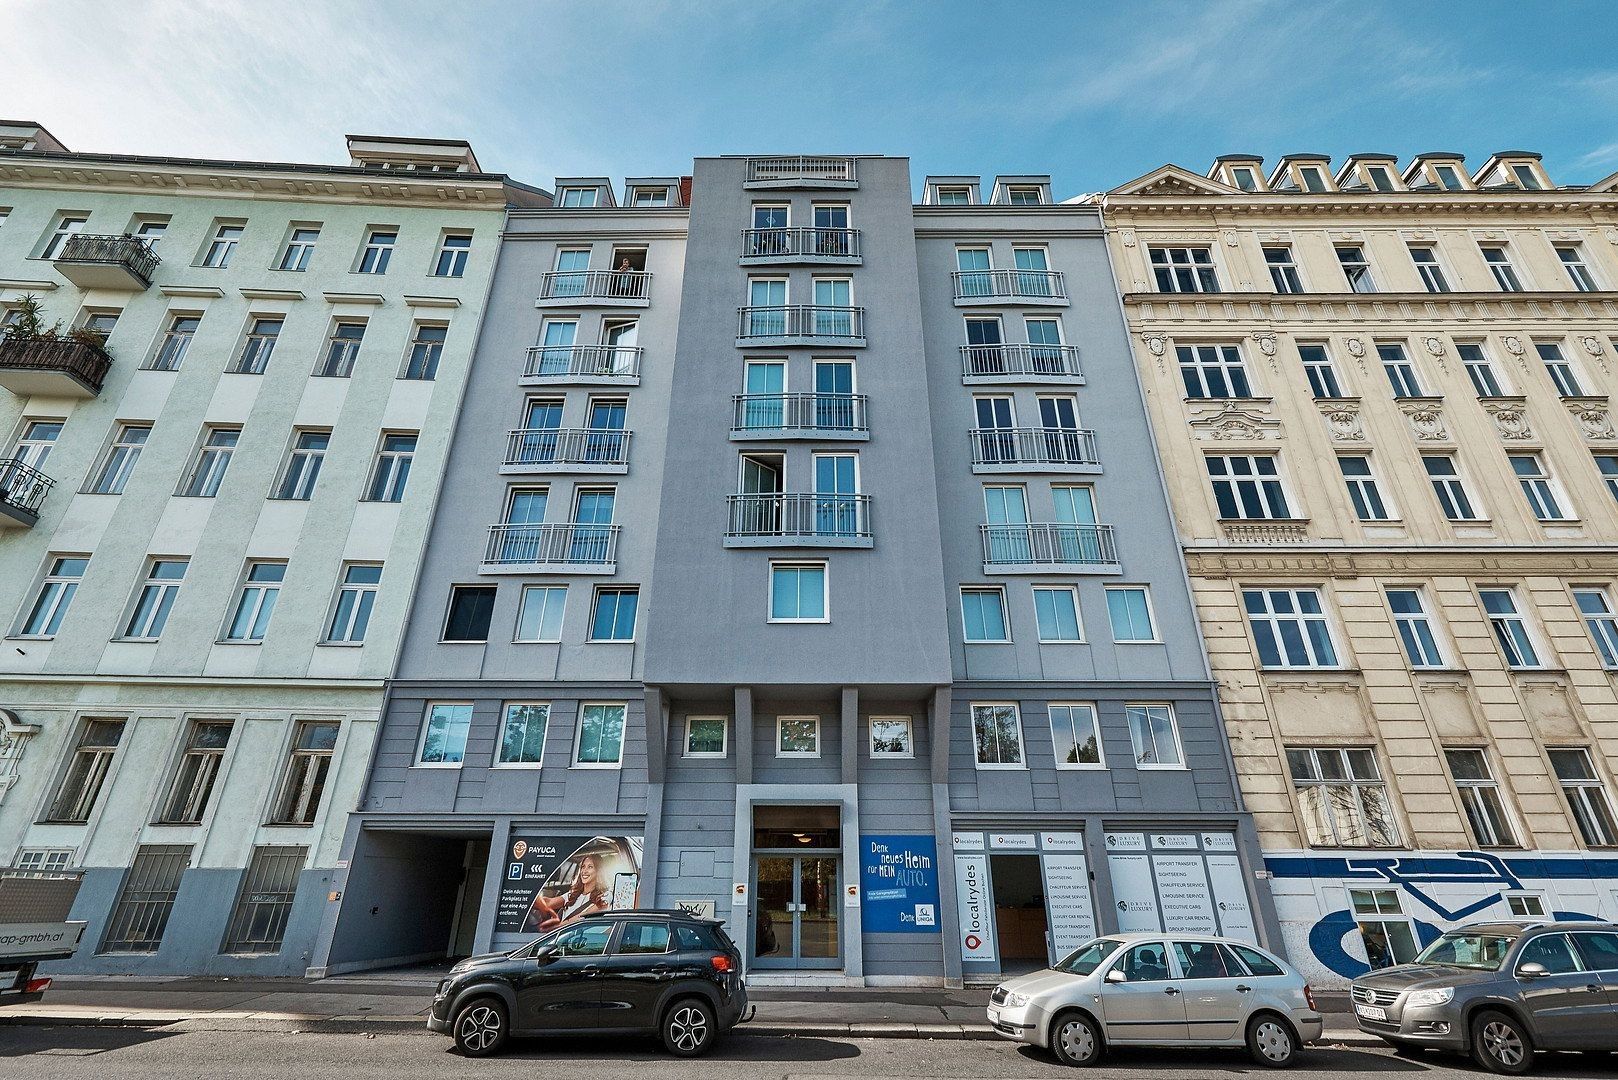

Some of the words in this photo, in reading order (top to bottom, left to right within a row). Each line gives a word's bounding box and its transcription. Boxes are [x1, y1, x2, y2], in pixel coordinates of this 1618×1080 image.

[528, 846, 556, 854] PAYUCA
[871, 841, 889, 853] Denk
[881, 853, 904, 864] neues
[904, 850, 931, 869] Heim
[512, 865, 520, 877] P
[879, 865, 896, 877] MEIN
[895, 869, 928, 887] AUTO.
[965, 864, 981, 933] localrydes
[0, 931, 64, 946] ap-gmbh.at
